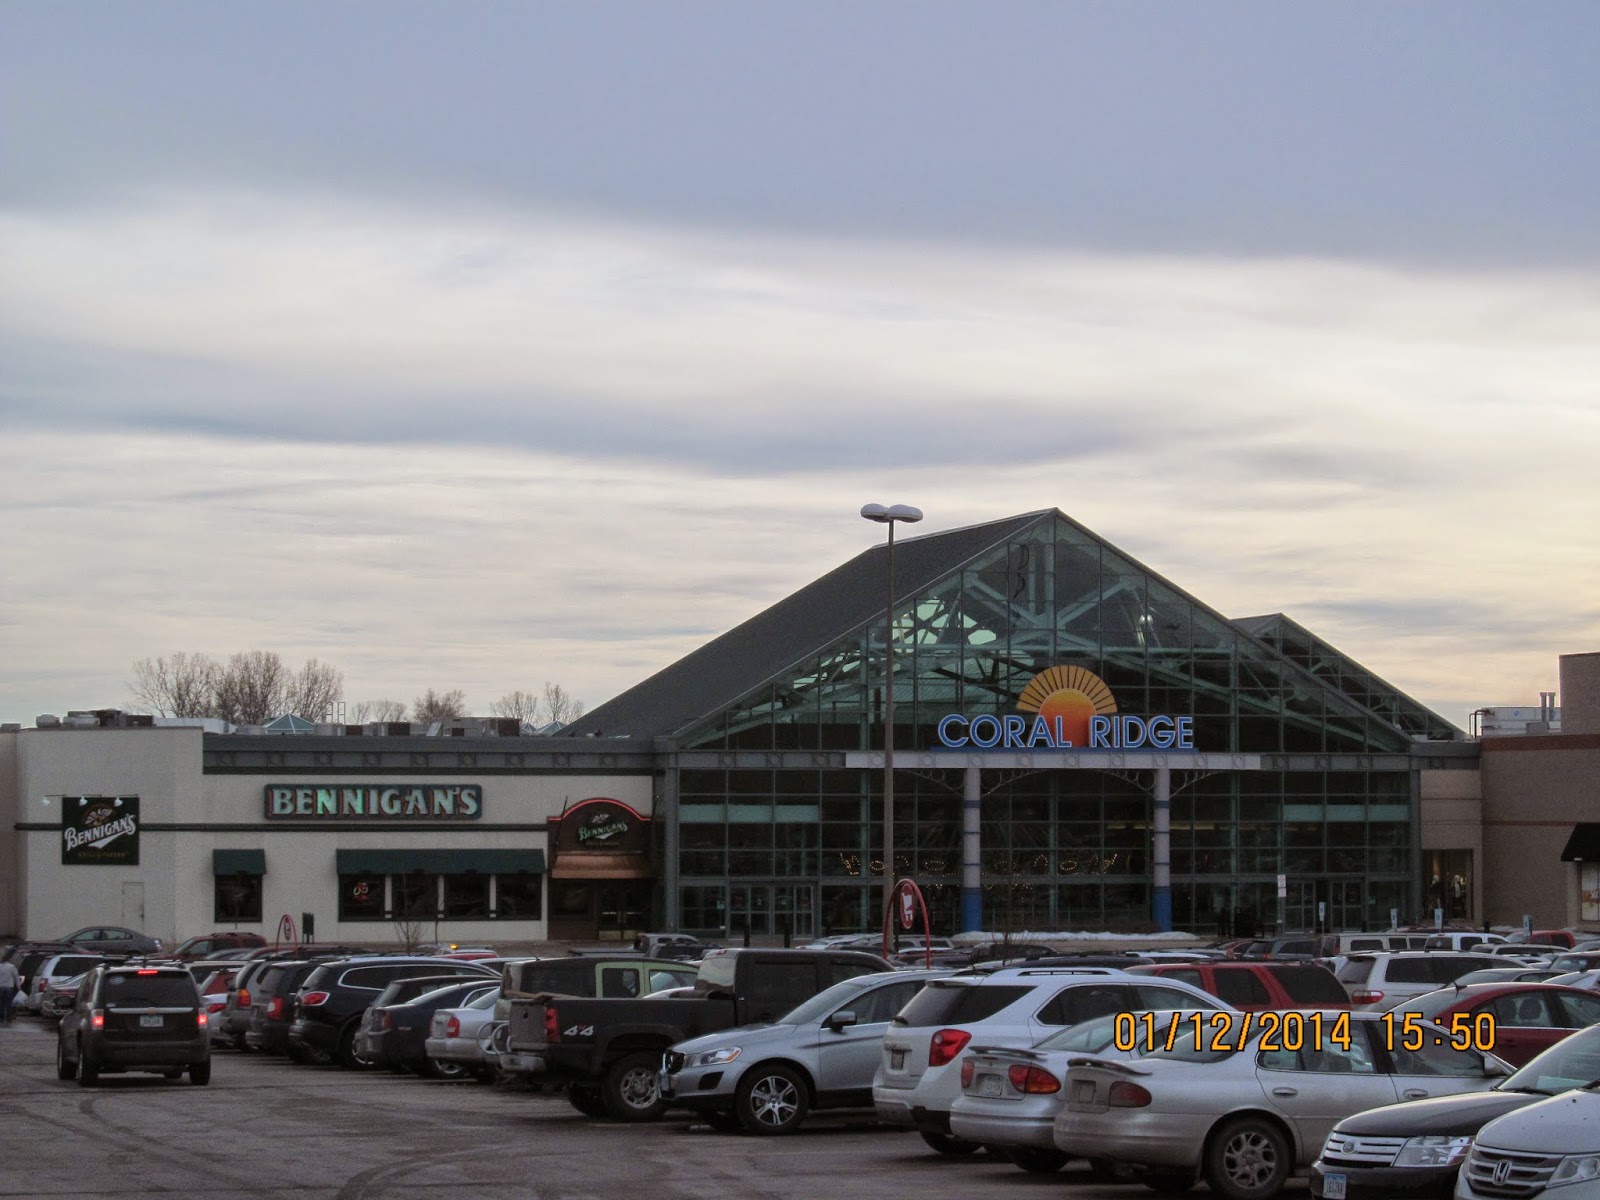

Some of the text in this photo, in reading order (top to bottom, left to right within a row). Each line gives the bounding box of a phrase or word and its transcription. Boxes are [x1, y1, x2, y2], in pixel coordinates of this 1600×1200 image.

[938, 714, 1194, 749] CORAL RIDGE
[271, 786, 478, 815] BENNIGAN'S
[64, 813, 136, 851] BENNIGAN'S
